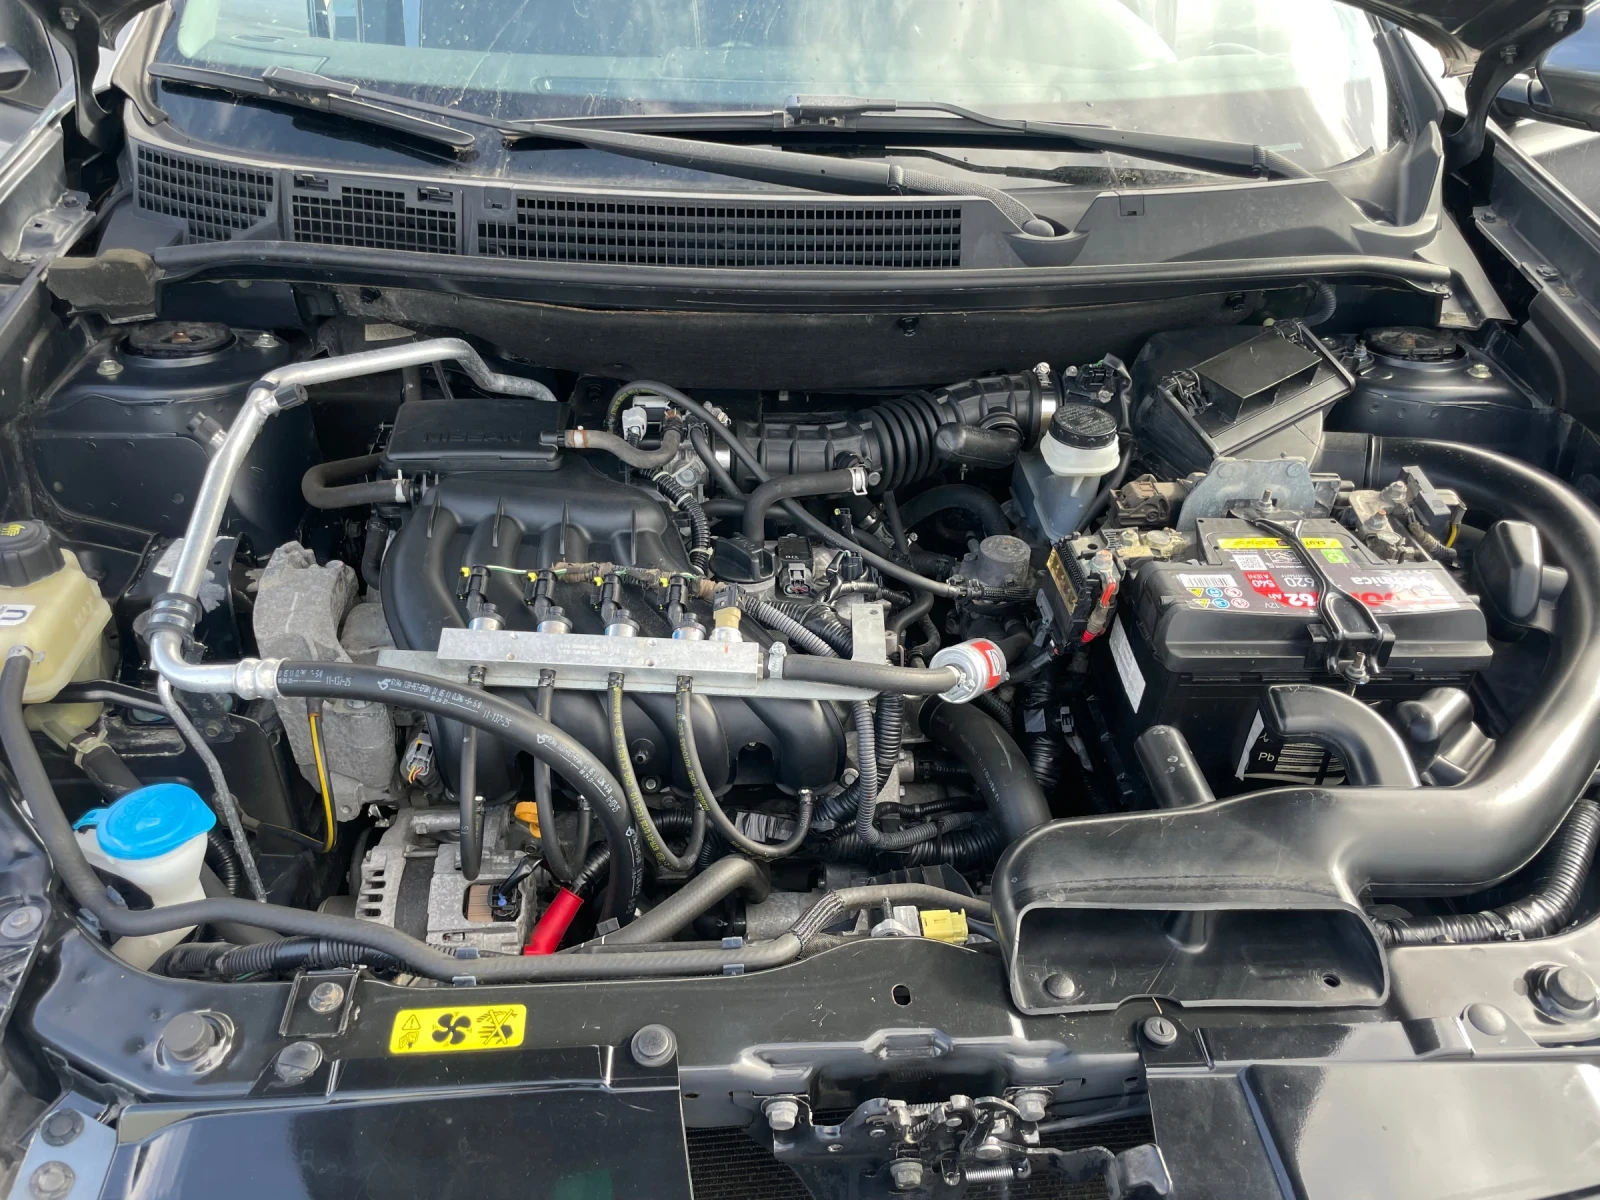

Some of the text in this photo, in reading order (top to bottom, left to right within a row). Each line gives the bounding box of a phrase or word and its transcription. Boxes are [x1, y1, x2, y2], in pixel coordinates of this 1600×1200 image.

[423, 430, 522, 443] NISSAN
[1251, 579, 1276, 588] 540
[1285, 577, 1316, 587] 620
[1284, 592, 1315, 607] 62
[482, 708, 513, 728] 11-137-25
[679, 738, 691, 768] AUTOGAS
[1258, 752, 1275, 762] Pb
[624, 772, 634, 787] CNG
[687, 769, 699, 787] HOSE
[630, 790, 639, 804] 110
[695, 788, 710, 812] RUBBER
[633, 802, 645, 818] ECE
